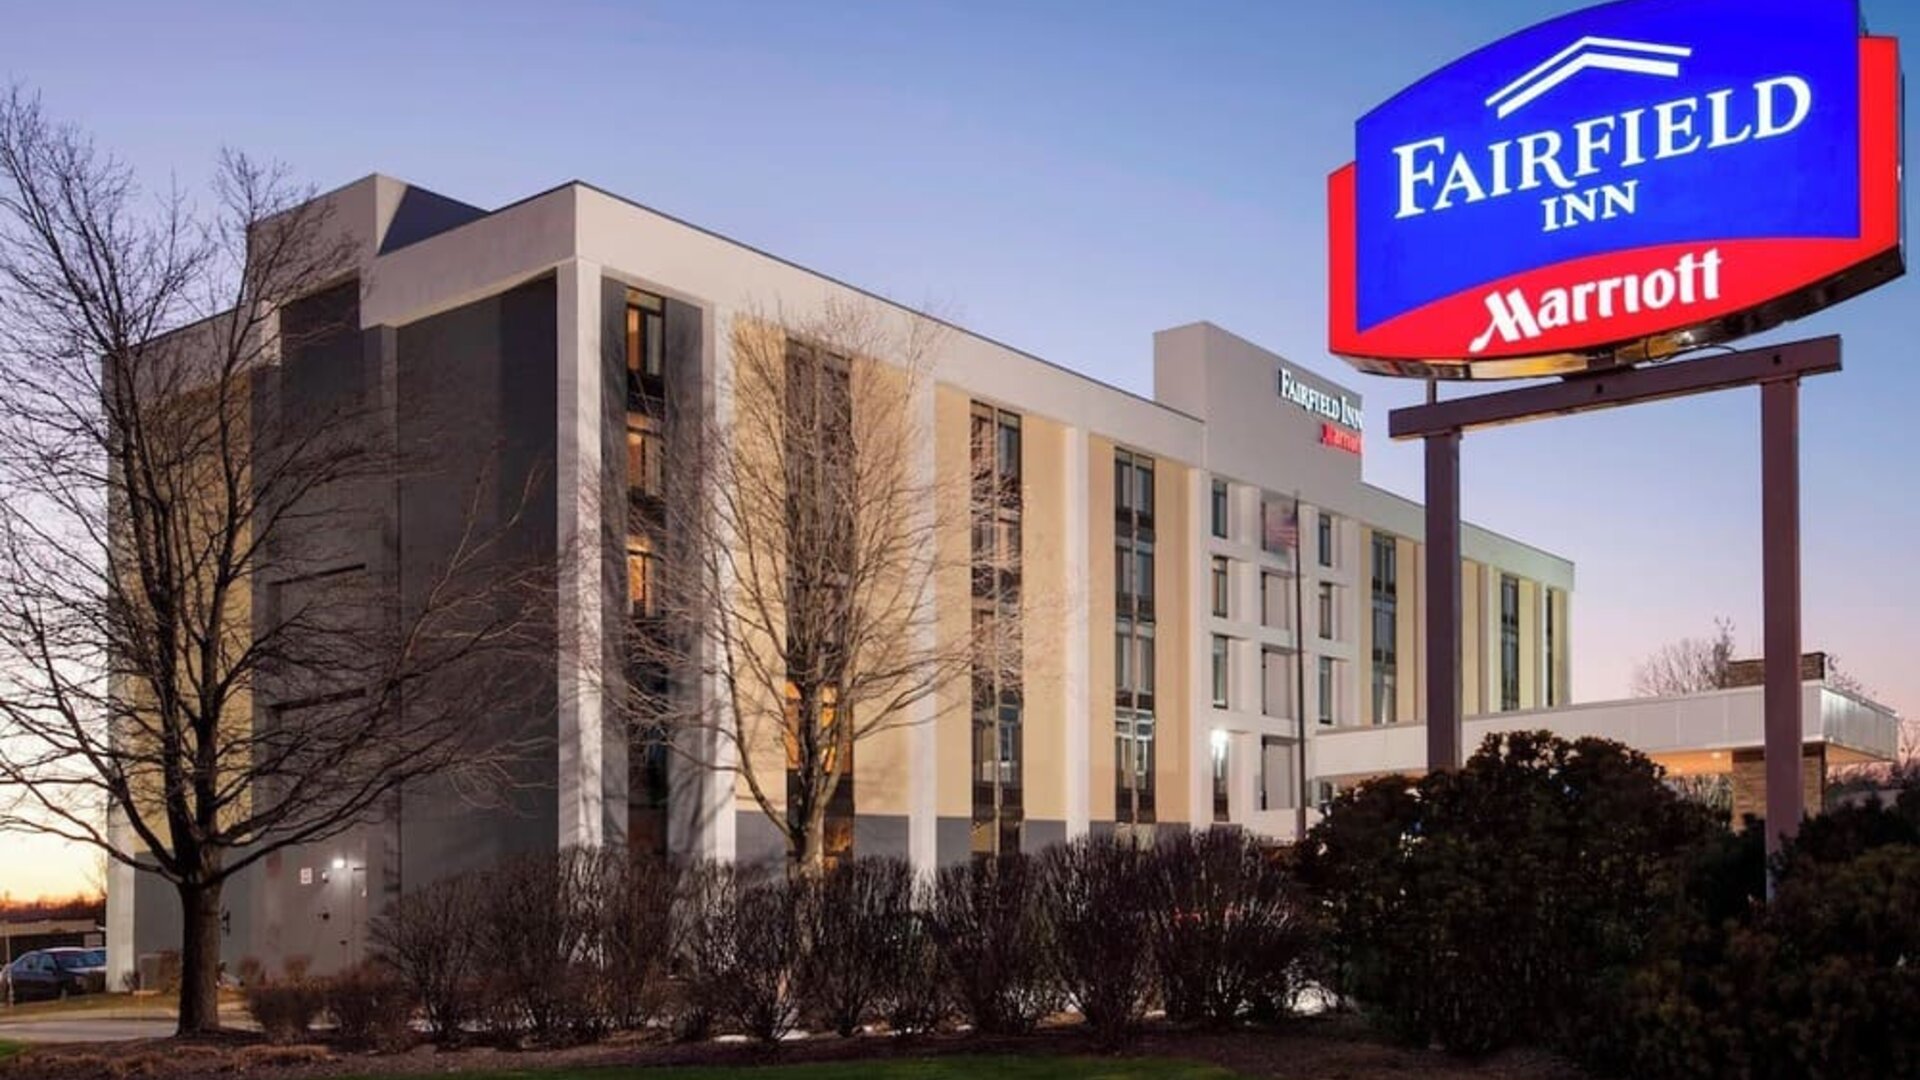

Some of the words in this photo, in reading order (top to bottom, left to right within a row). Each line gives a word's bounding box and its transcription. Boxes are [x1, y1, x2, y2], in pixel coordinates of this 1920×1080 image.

[1393, 75, 1812, 219] FAIRFIELD
[1540, 180, 1639, 232] INN
[1468, 248, 1722, 352] Marriott
[1280, 368, 1341, 420] FAIRFIELD
